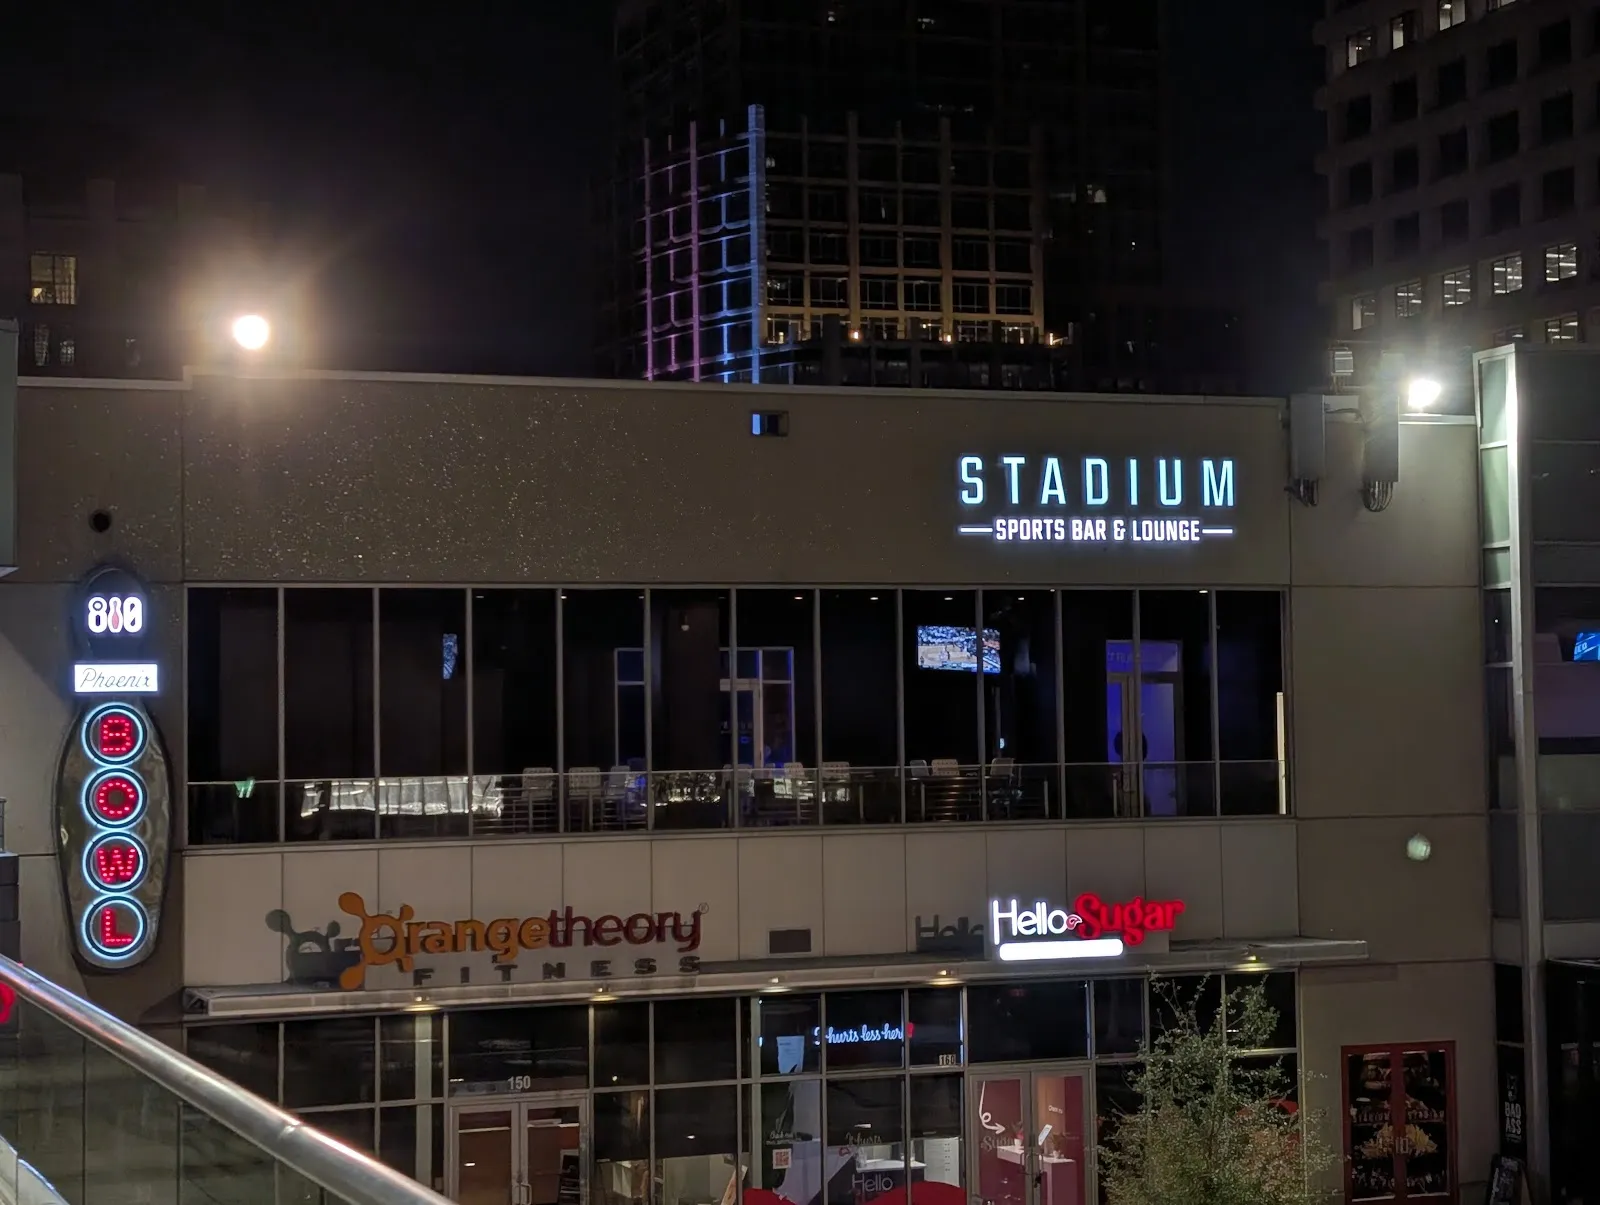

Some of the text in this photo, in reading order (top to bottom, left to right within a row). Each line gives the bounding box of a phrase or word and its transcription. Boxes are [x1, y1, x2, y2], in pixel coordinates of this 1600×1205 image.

[960, 456, 1234, 507] STADIUM
[995, 518, 1200, 542] SPORTS BAR & LOUNGE
[88, 596, 142, 633] 810
[79, 667, 151, 688] Phoenix
[97, 717, 136, 946] BOWL
[992, 899, 1067, 945] Hello
[1075, 892, 1185, 946] Sugar
[413, 955, 700, 986] FITNESS
[825, 1026, 859, 1044] hurts
[860, 1023, 881, 1042] less
[940, 1054, 956, 1066] 160
[507, 1075, 531, 1091] 150
[1505, 1118, 1522, 1135] ASS
[852, 1172, 893, 1197] Hello
